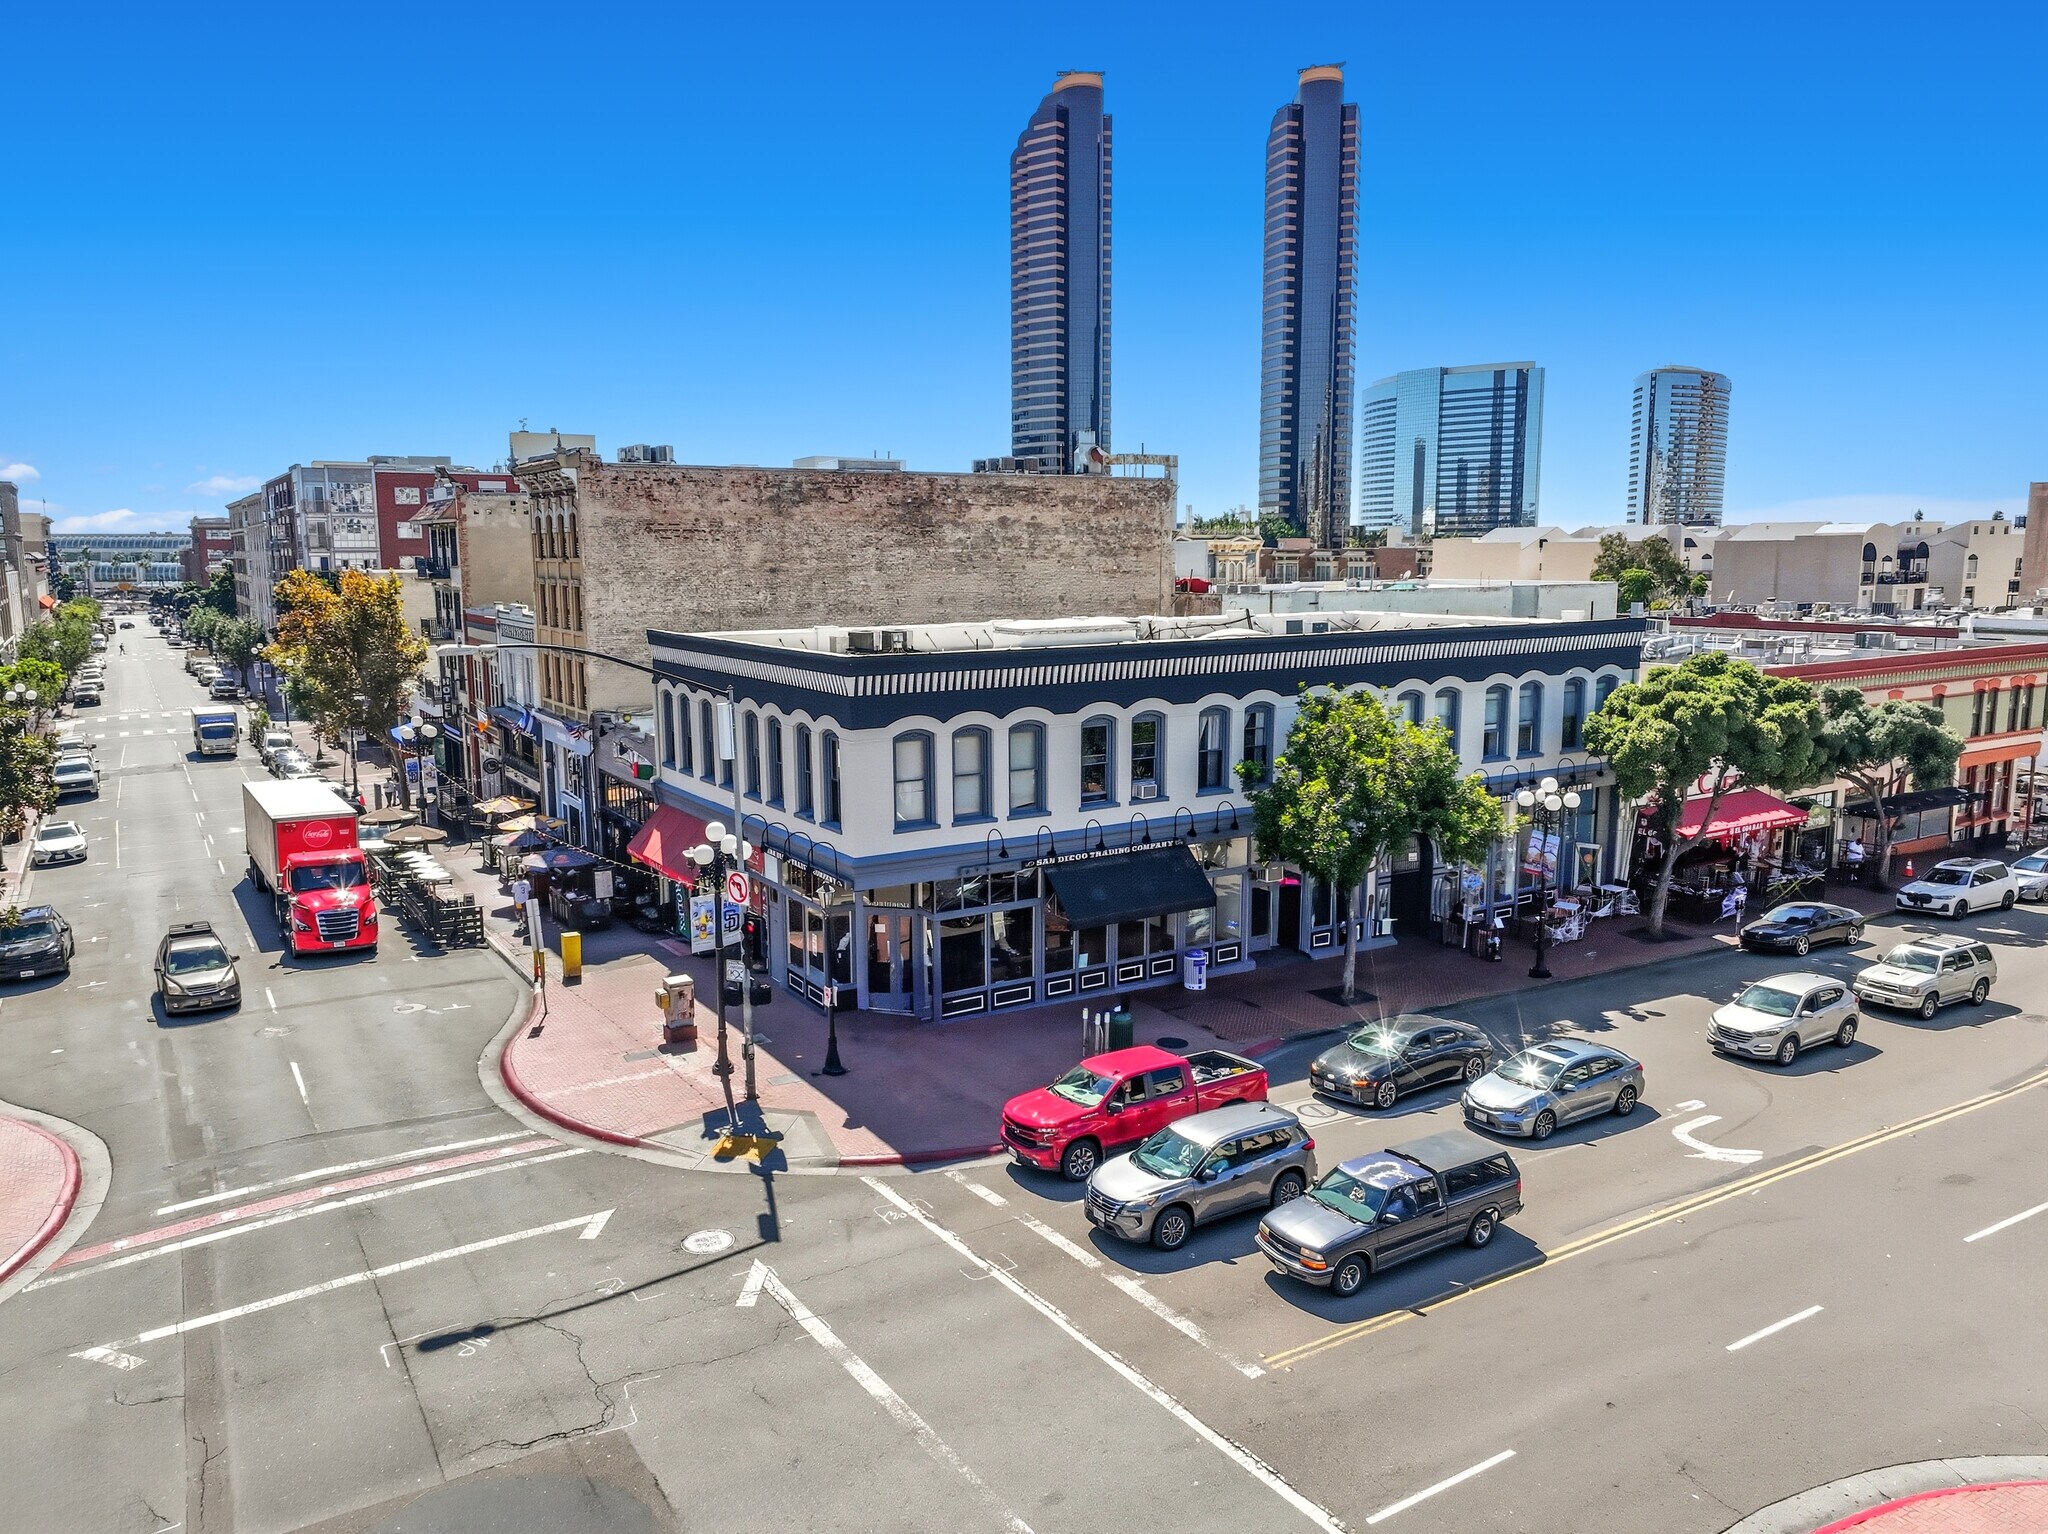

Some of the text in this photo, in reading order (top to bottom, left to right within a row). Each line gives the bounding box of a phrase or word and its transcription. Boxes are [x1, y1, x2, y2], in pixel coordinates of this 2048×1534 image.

[442, 678, 452, 718] HOTEL
[1036, 840, 1174, 867] SAN DIEGO TRADING COMPANY
[520, 886, 526, 894] 3
